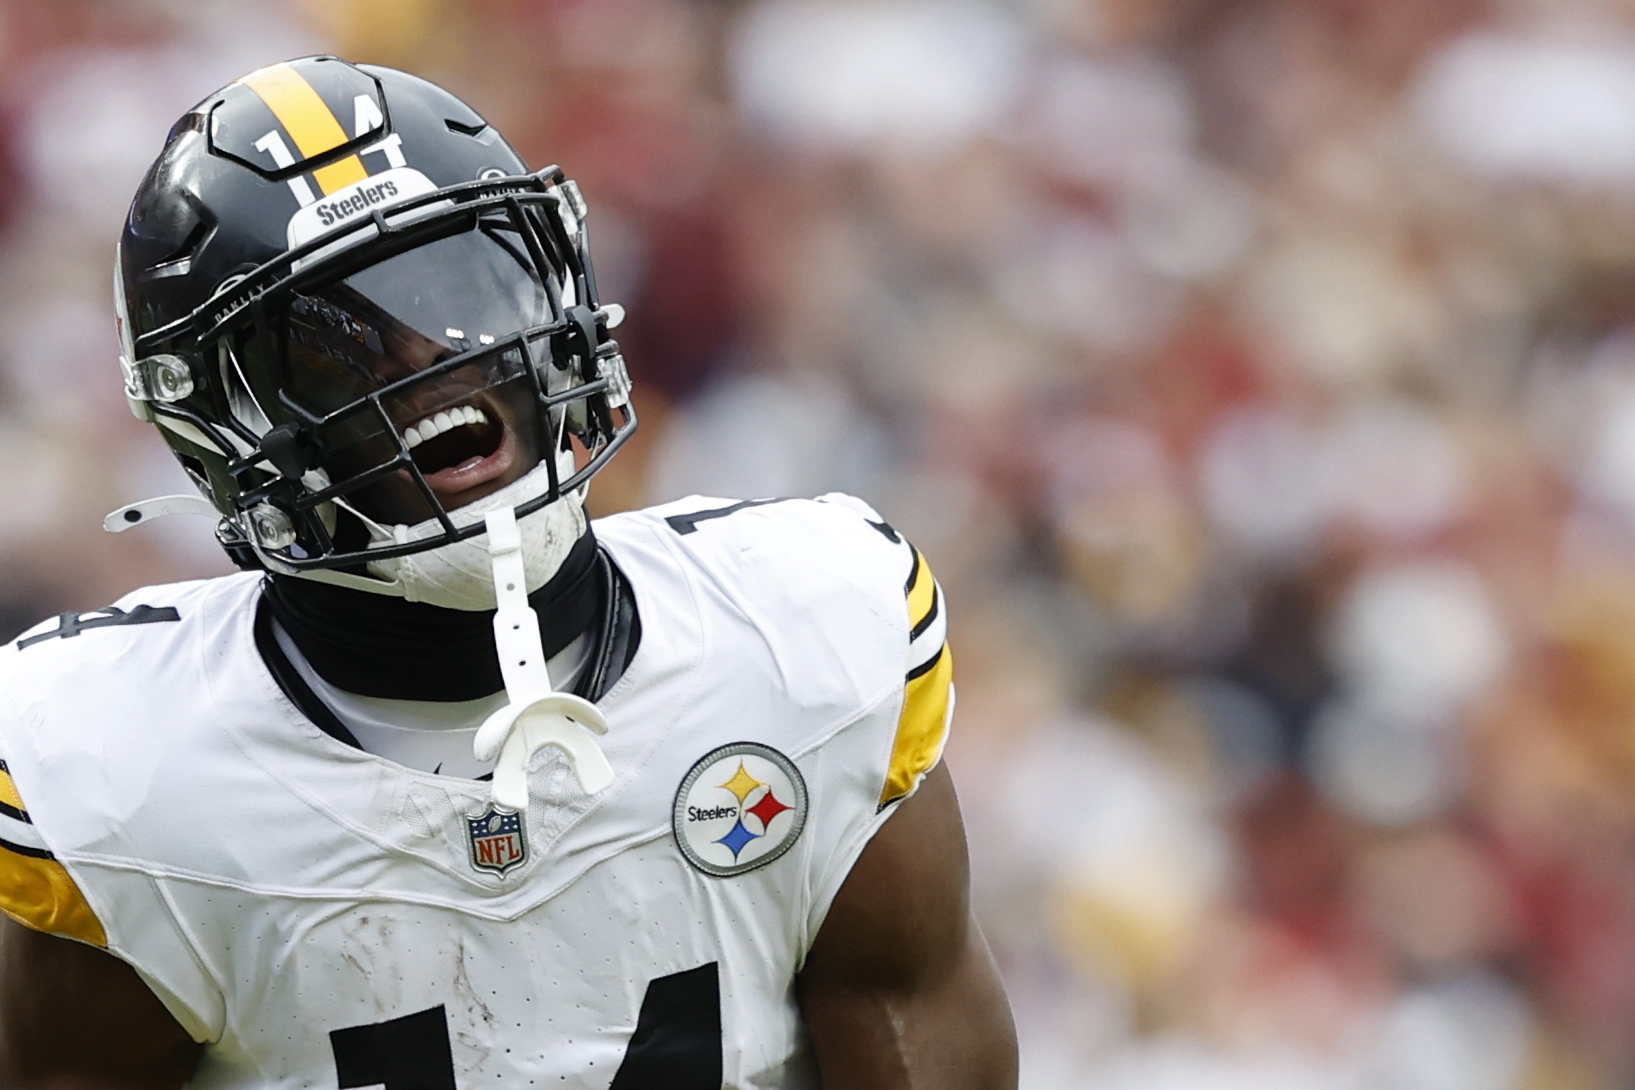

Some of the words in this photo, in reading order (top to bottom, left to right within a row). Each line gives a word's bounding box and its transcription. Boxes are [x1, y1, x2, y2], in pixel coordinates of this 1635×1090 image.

[315, 180, 399, 226] Steelers
[687, 805, 738, 822] Steelers
[476, 835, 520, 866] NFL
